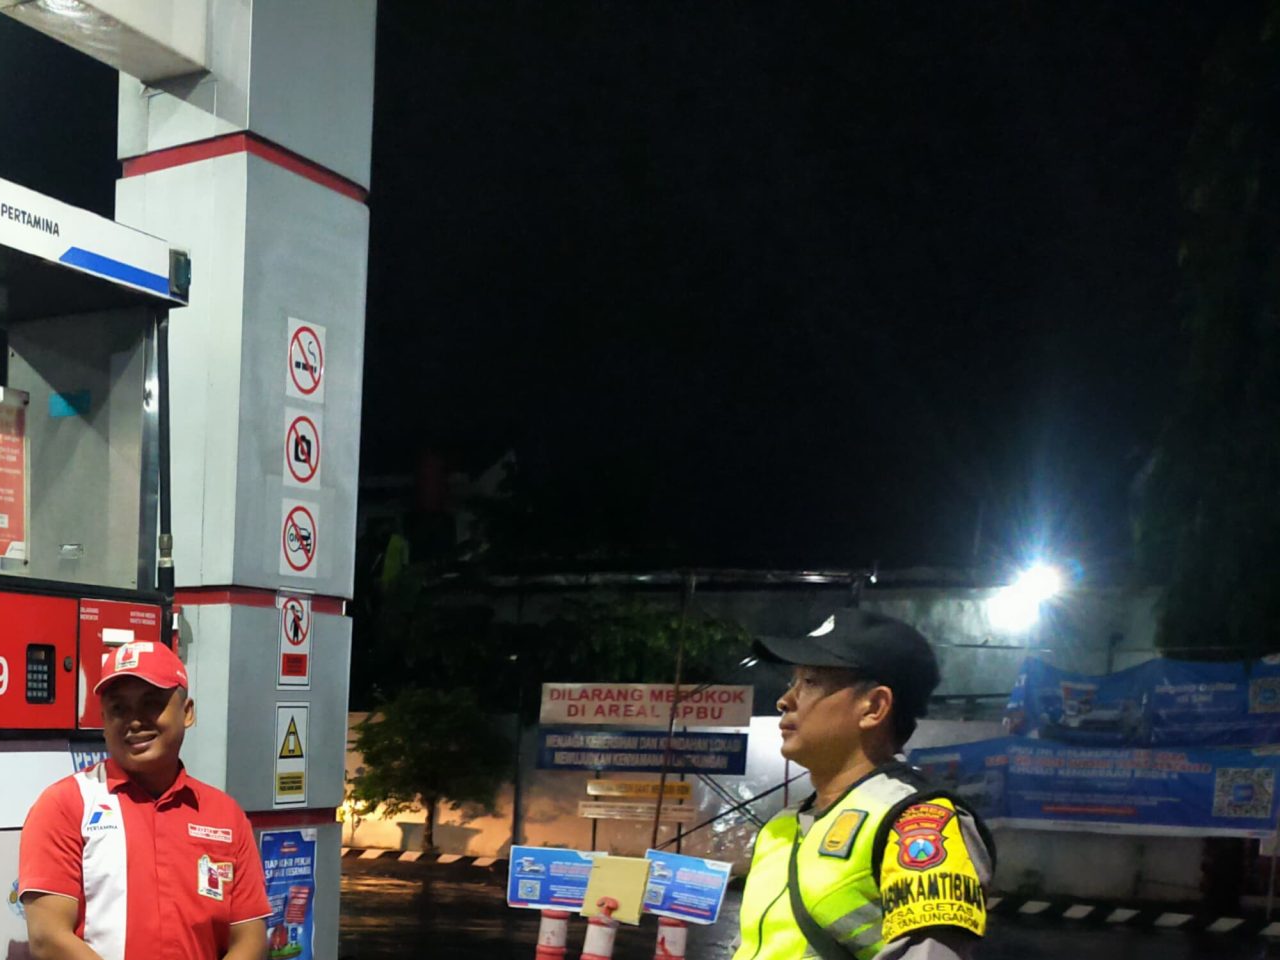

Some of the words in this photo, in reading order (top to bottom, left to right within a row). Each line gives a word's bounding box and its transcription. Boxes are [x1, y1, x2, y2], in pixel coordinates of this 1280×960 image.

[1, 202, 60, 237] PERTAMINA
[550, 687, 643, 702] DILARANG
[567, 704, 586, 718] DI
[594, 704, 661, 719] AREAL
[922, 902, 974, 917] GETAS
